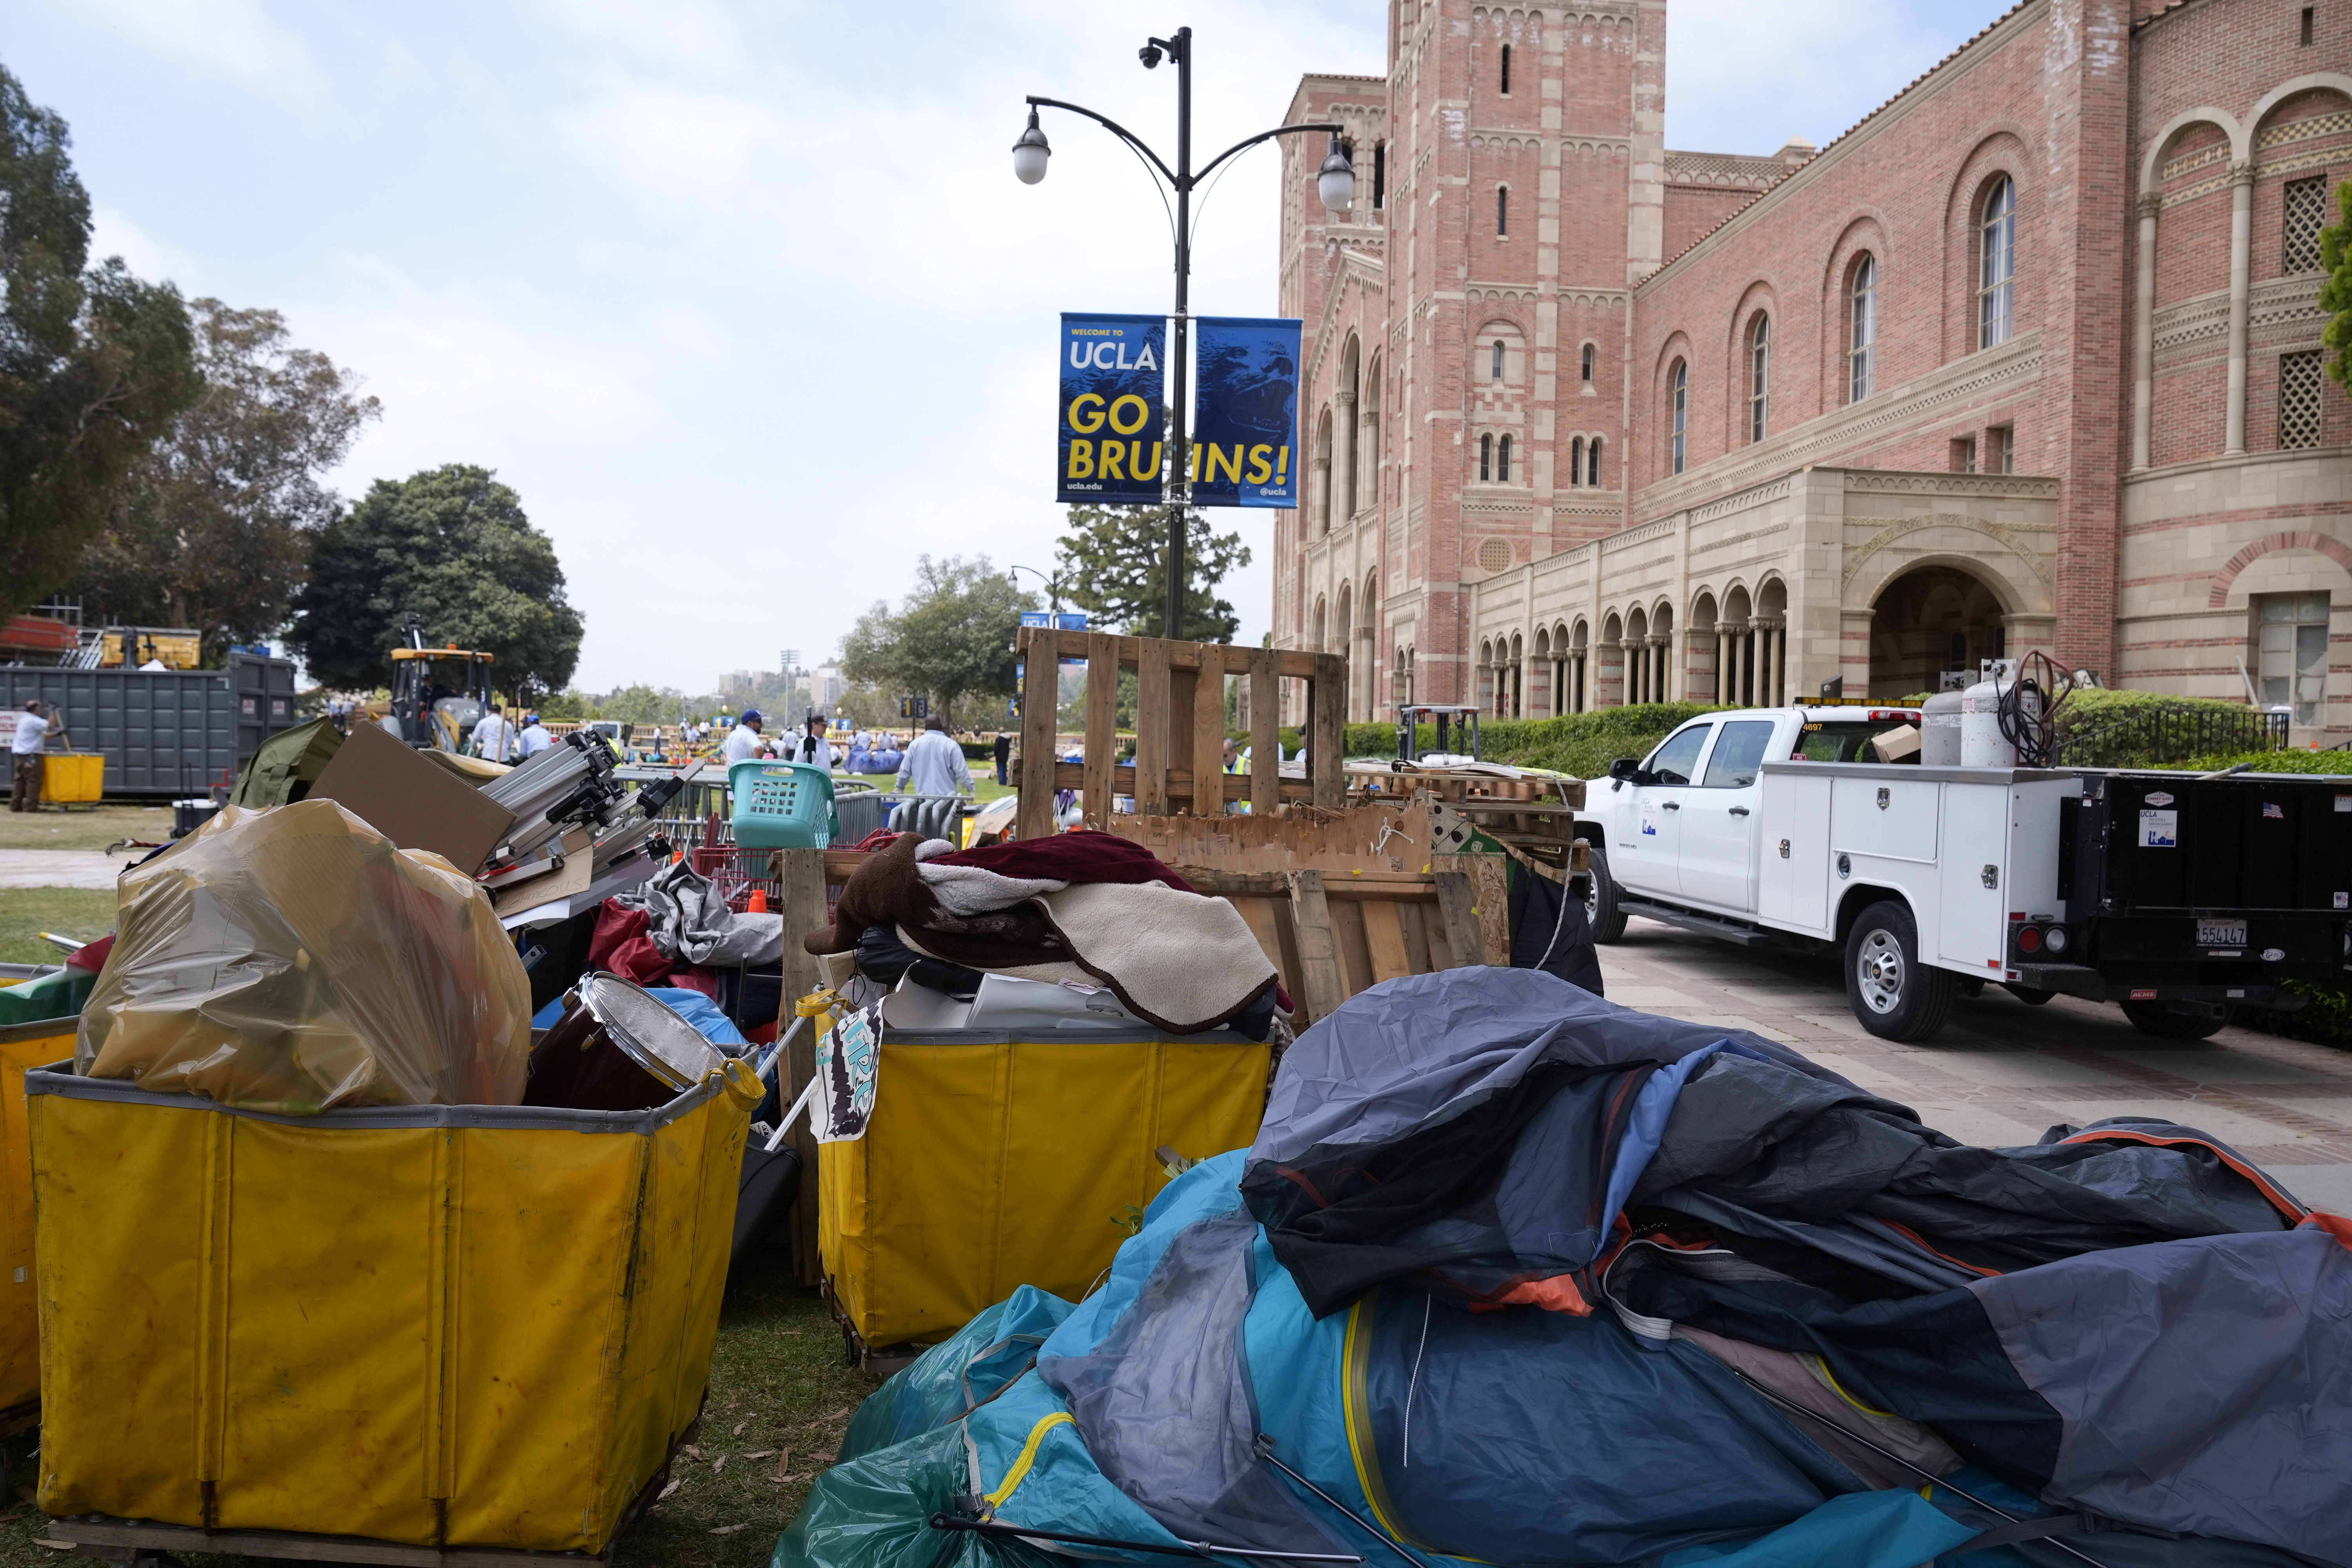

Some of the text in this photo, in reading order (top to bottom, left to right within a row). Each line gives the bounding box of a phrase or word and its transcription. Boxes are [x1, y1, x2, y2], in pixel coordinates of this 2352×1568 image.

[1070, 341, 1158, 371] UCLA
[1068, 393, 1149, 435] GO
[1260, 488, 1287, 496] @ucla
[494, 878, 582, 913] scellaneous
[2197, 928, 2244, 943] 1554147
